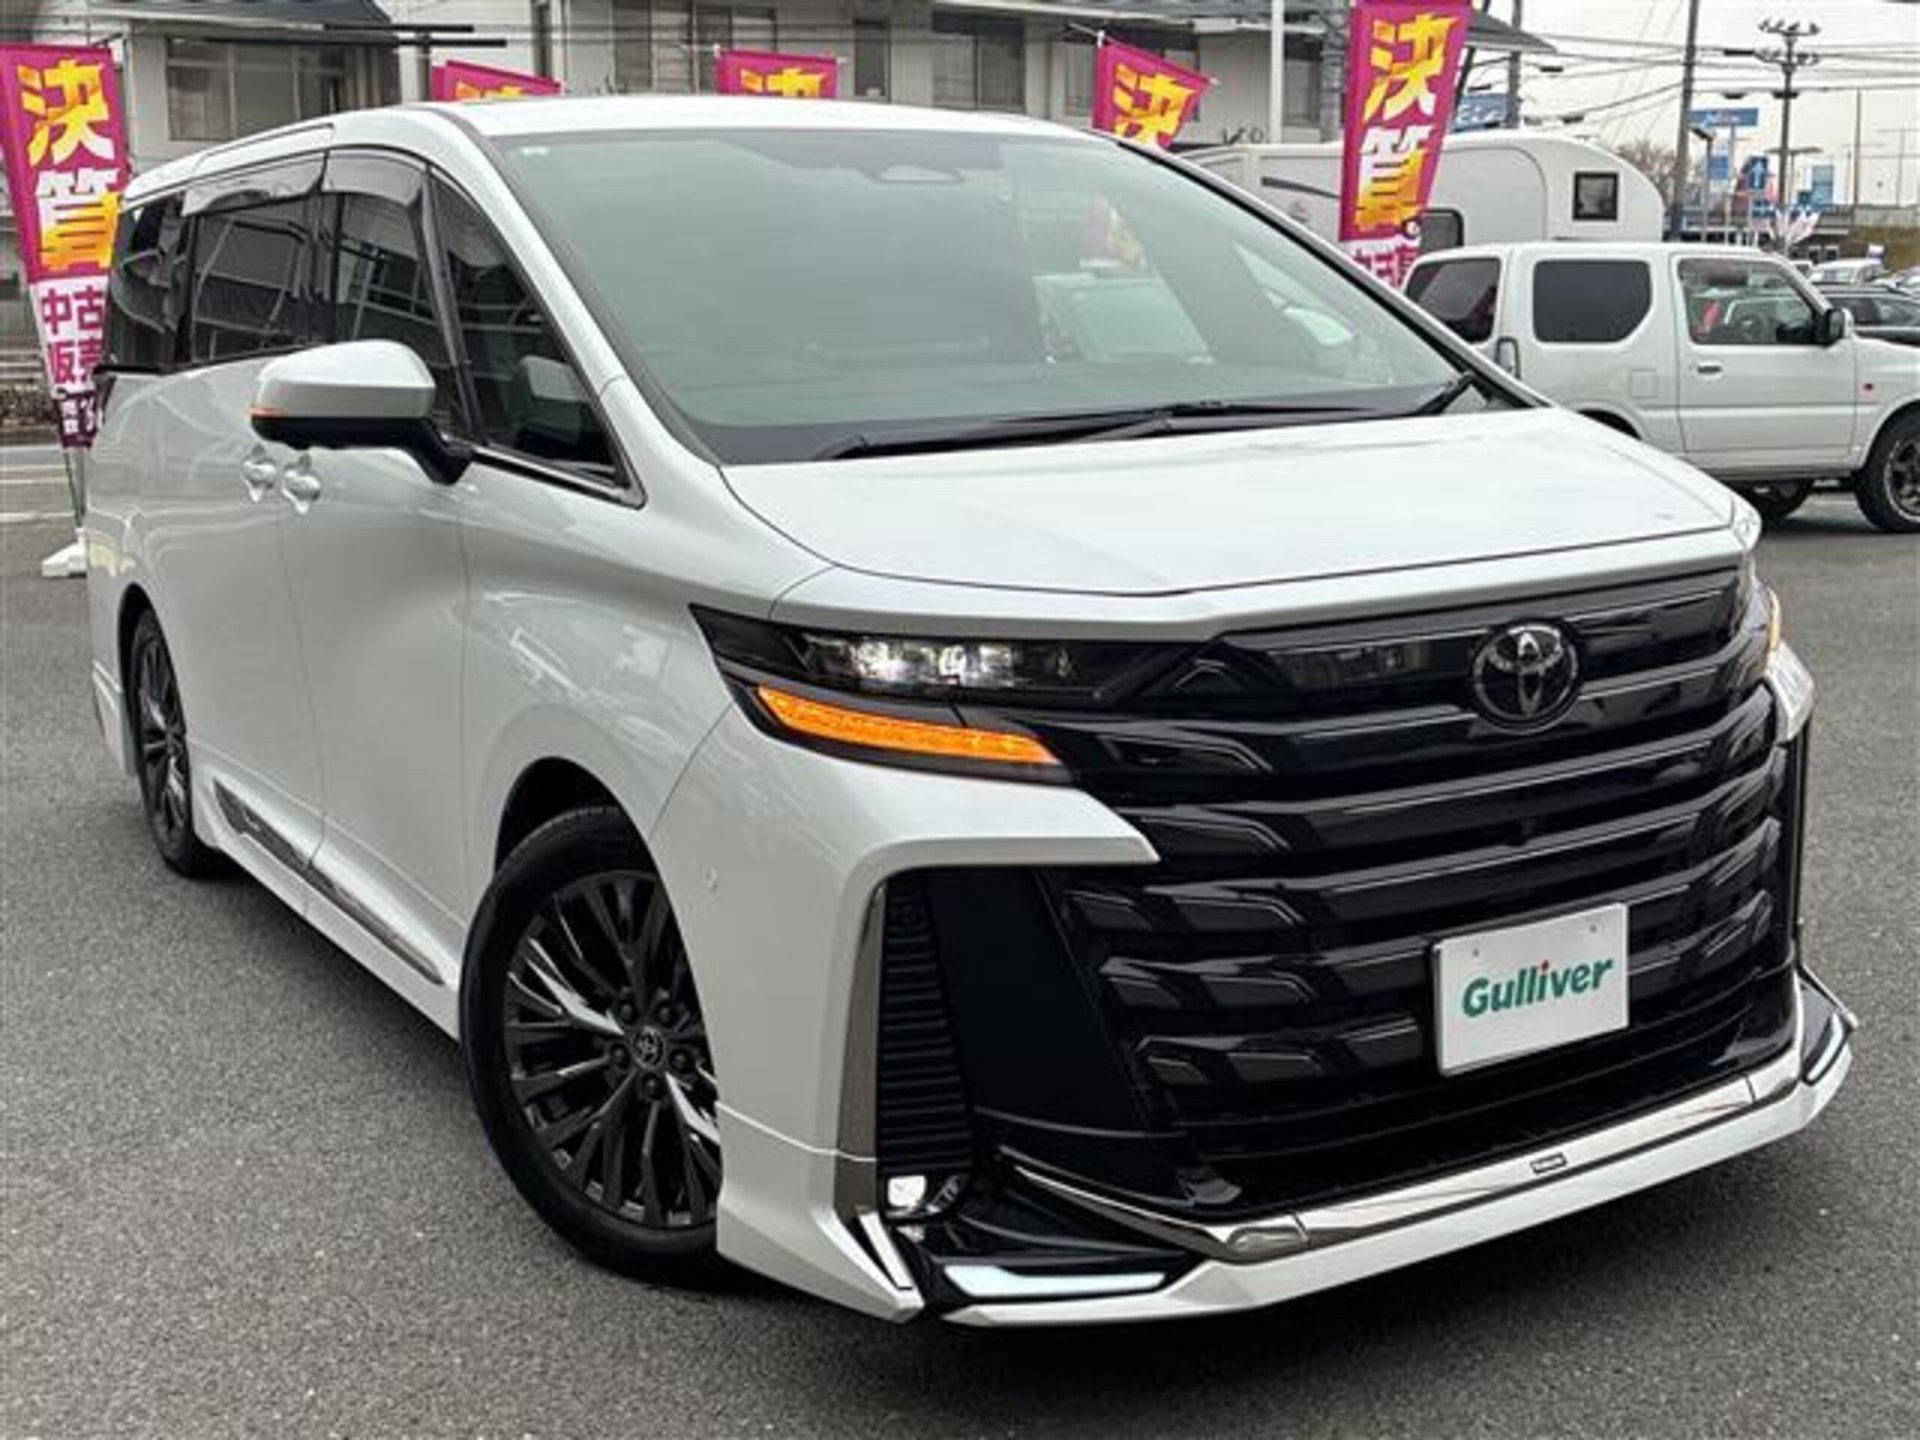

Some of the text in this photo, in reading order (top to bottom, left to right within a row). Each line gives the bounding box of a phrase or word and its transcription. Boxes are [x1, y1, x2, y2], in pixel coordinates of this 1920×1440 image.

[17, 60, 119, 269] 決算
[1356, 13, 1458, 232] 決算
[1462, 958, 1614, 1017] Gulliver
